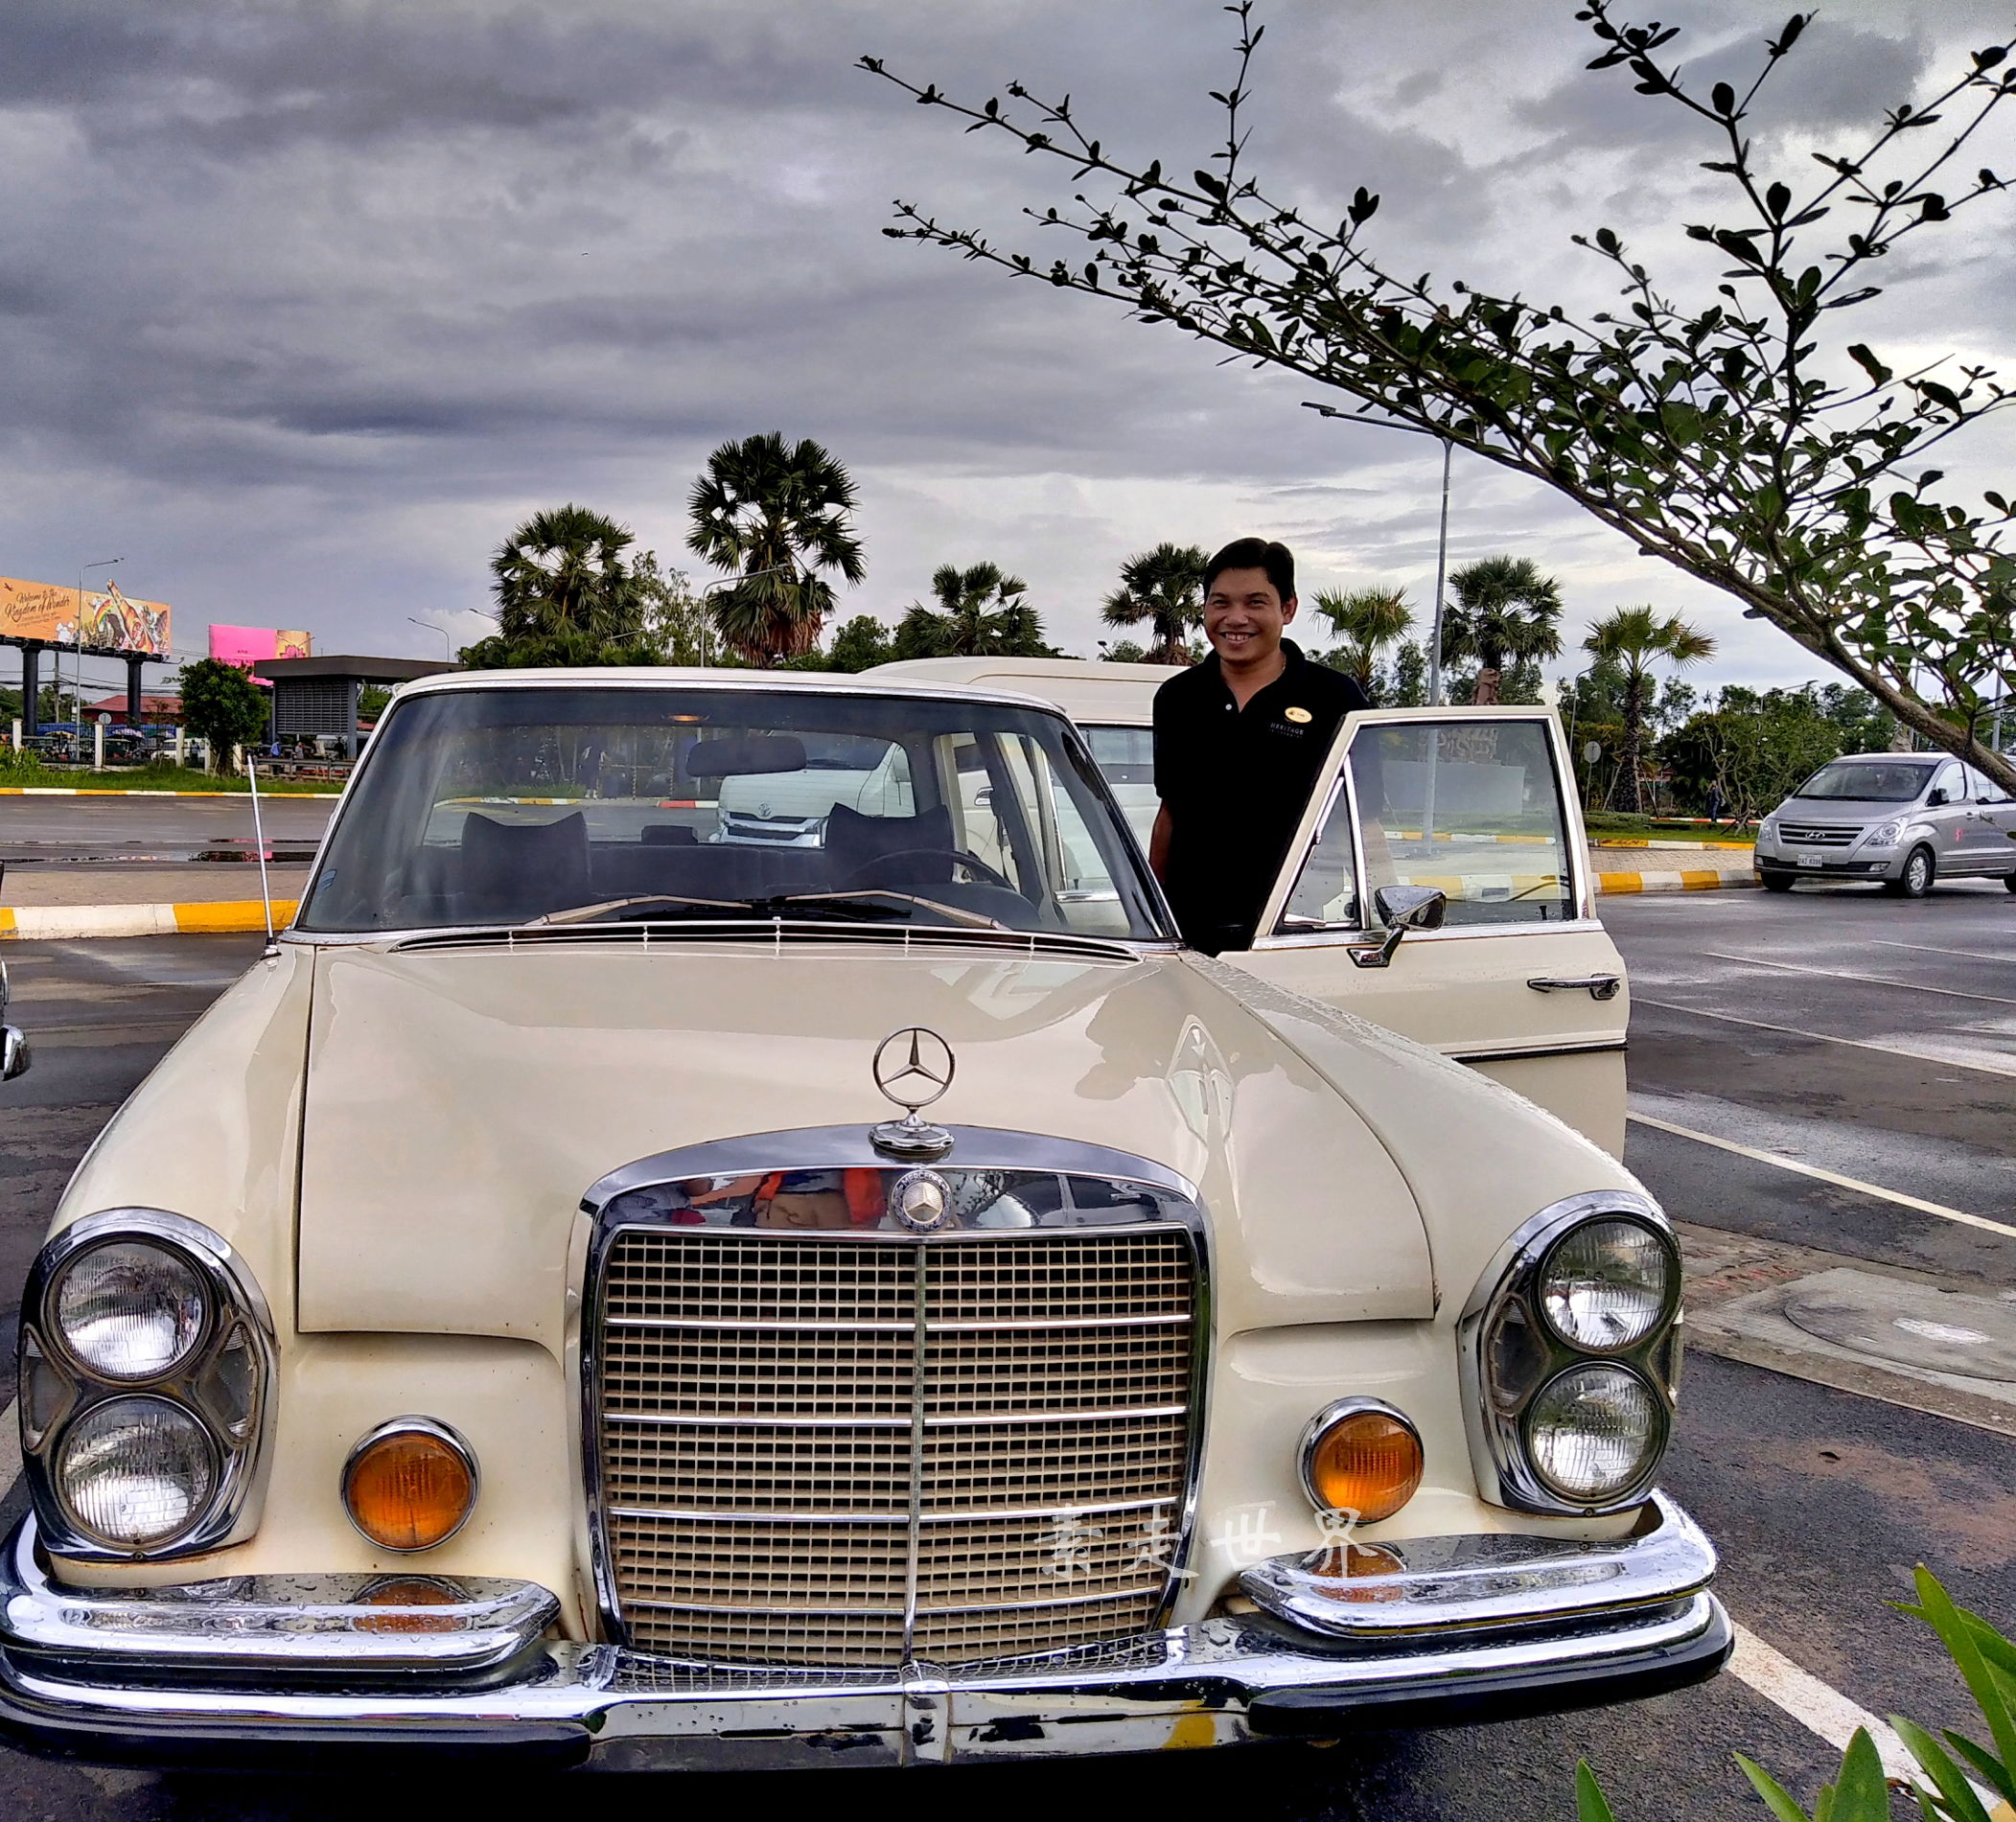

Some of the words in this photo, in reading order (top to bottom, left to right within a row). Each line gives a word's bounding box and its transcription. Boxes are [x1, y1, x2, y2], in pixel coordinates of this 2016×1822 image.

[16, 591, 41, 604] Welcome
[5, 603, 36, 623] Kingdom
[46, 596, 69, 611] Wonder
[1270, 723, 1304, 735] HERITAGE
[900, 1172, 943, 1186] MERCEDES
